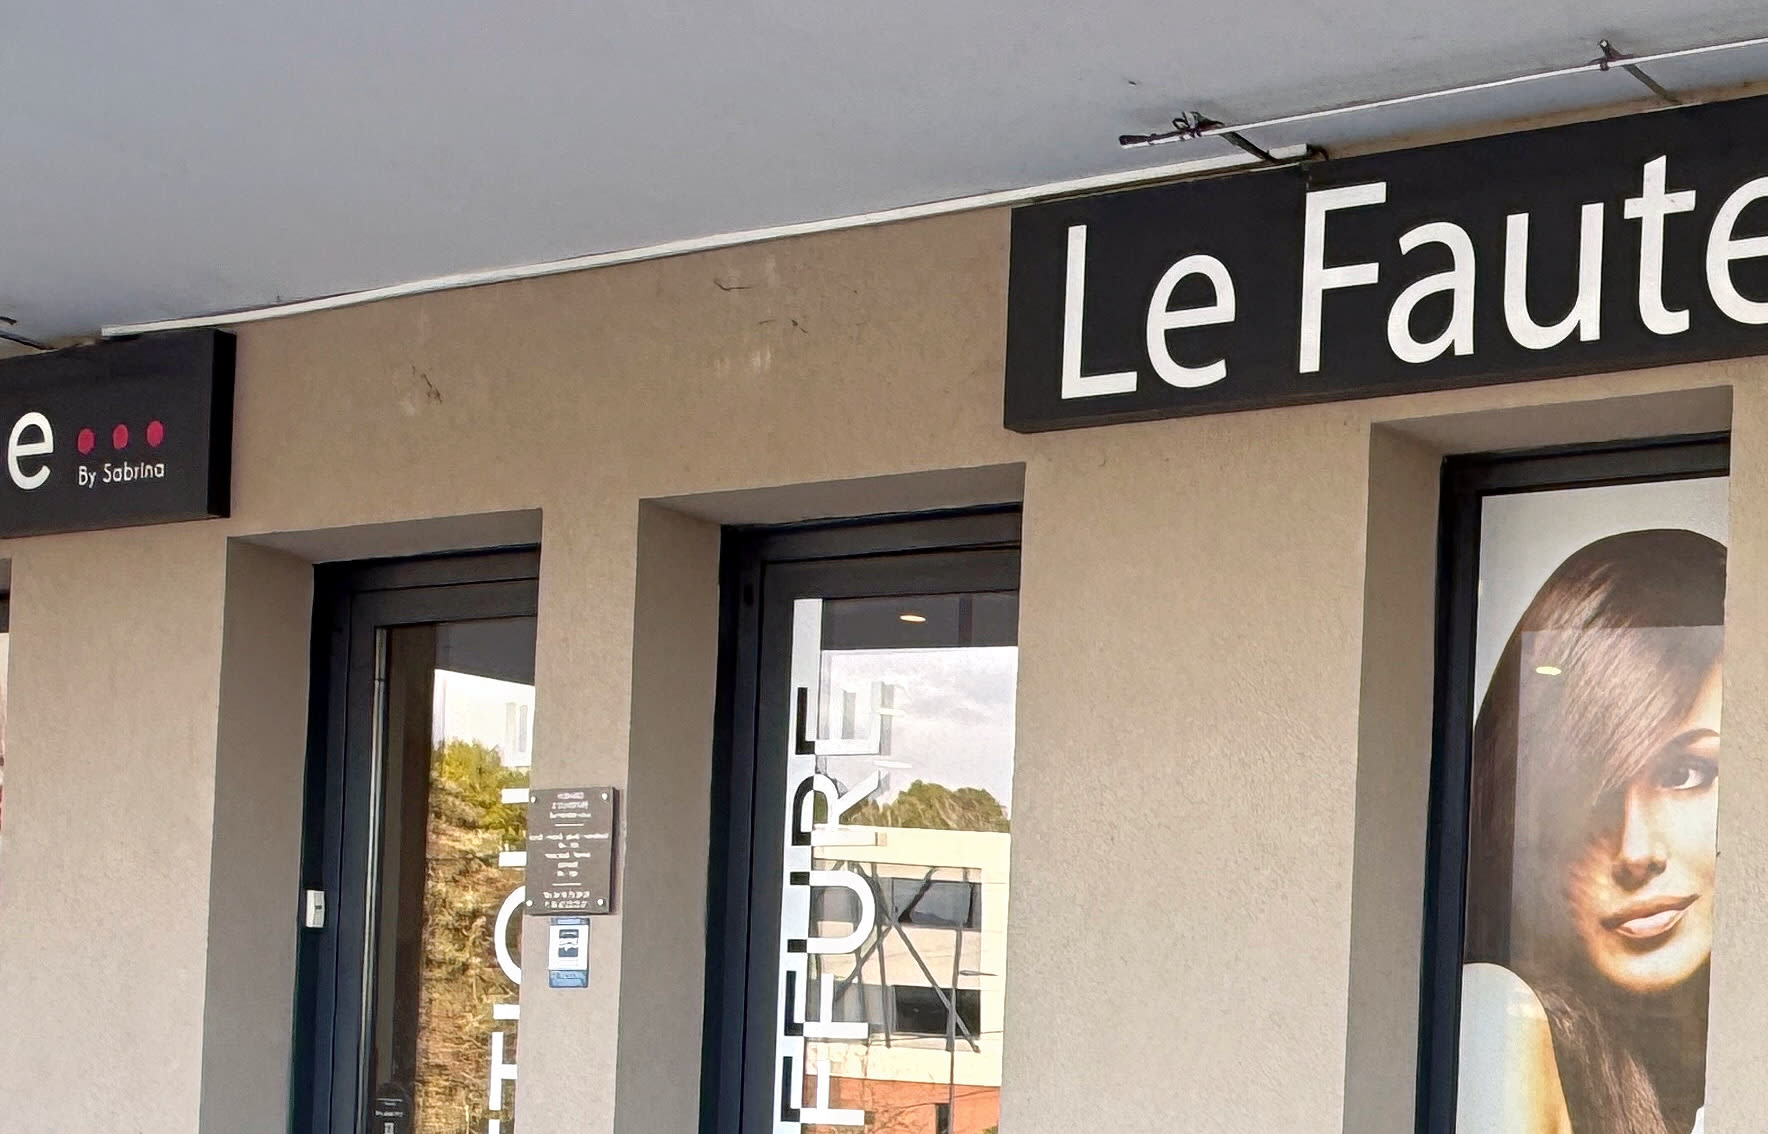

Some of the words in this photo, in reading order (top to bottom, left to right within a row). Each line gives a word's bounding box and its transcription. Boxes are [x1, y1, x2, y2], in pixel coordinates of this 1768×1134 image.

[1061, 224, 1236, 399] Le
[8, 411, 54, 490] e
[78, 466, 97, 489] By
[102, 462, 165, 483] Sabrina
